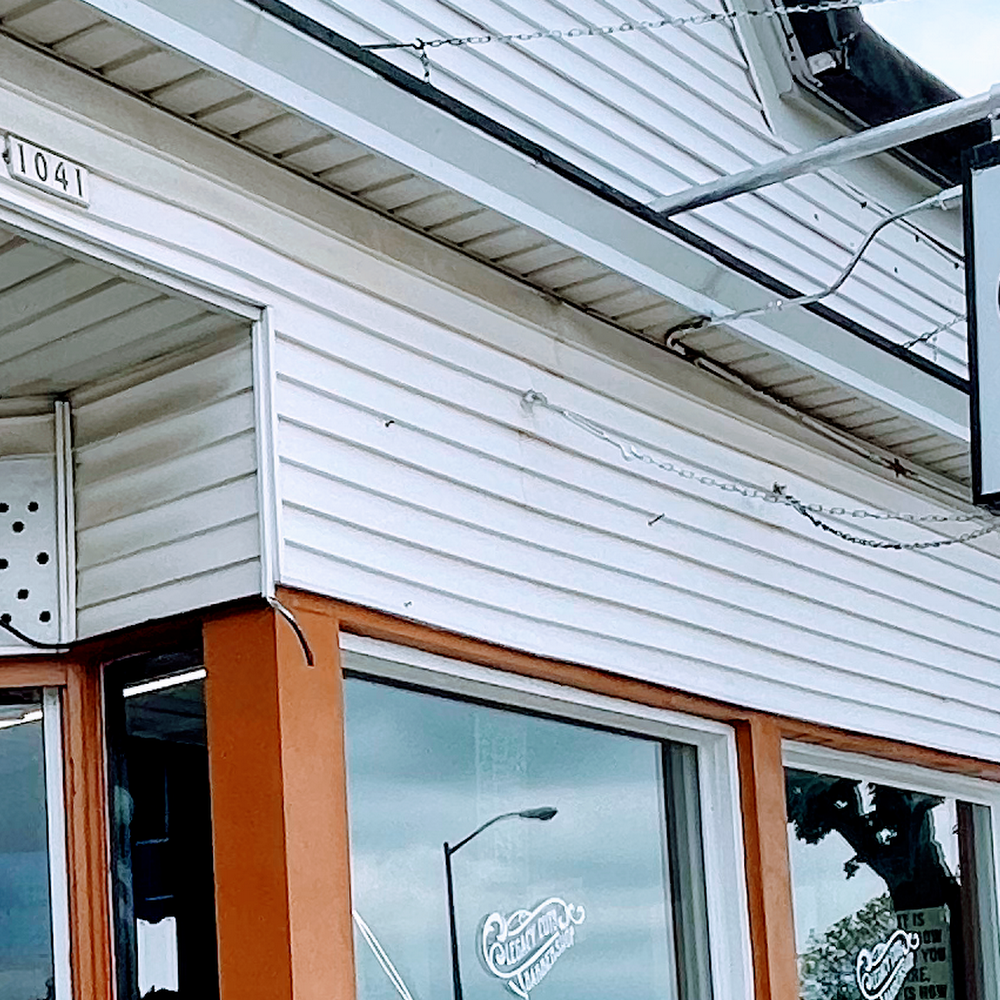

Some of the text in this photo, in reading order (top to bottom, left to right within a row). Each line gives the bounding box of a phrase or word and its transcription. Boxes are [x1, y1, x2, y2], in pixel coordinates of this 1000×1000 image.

[17, 143, 83, 197] 1041
[913, 913, 925, 926] IS
[921, 947, 946, 962] YOU
